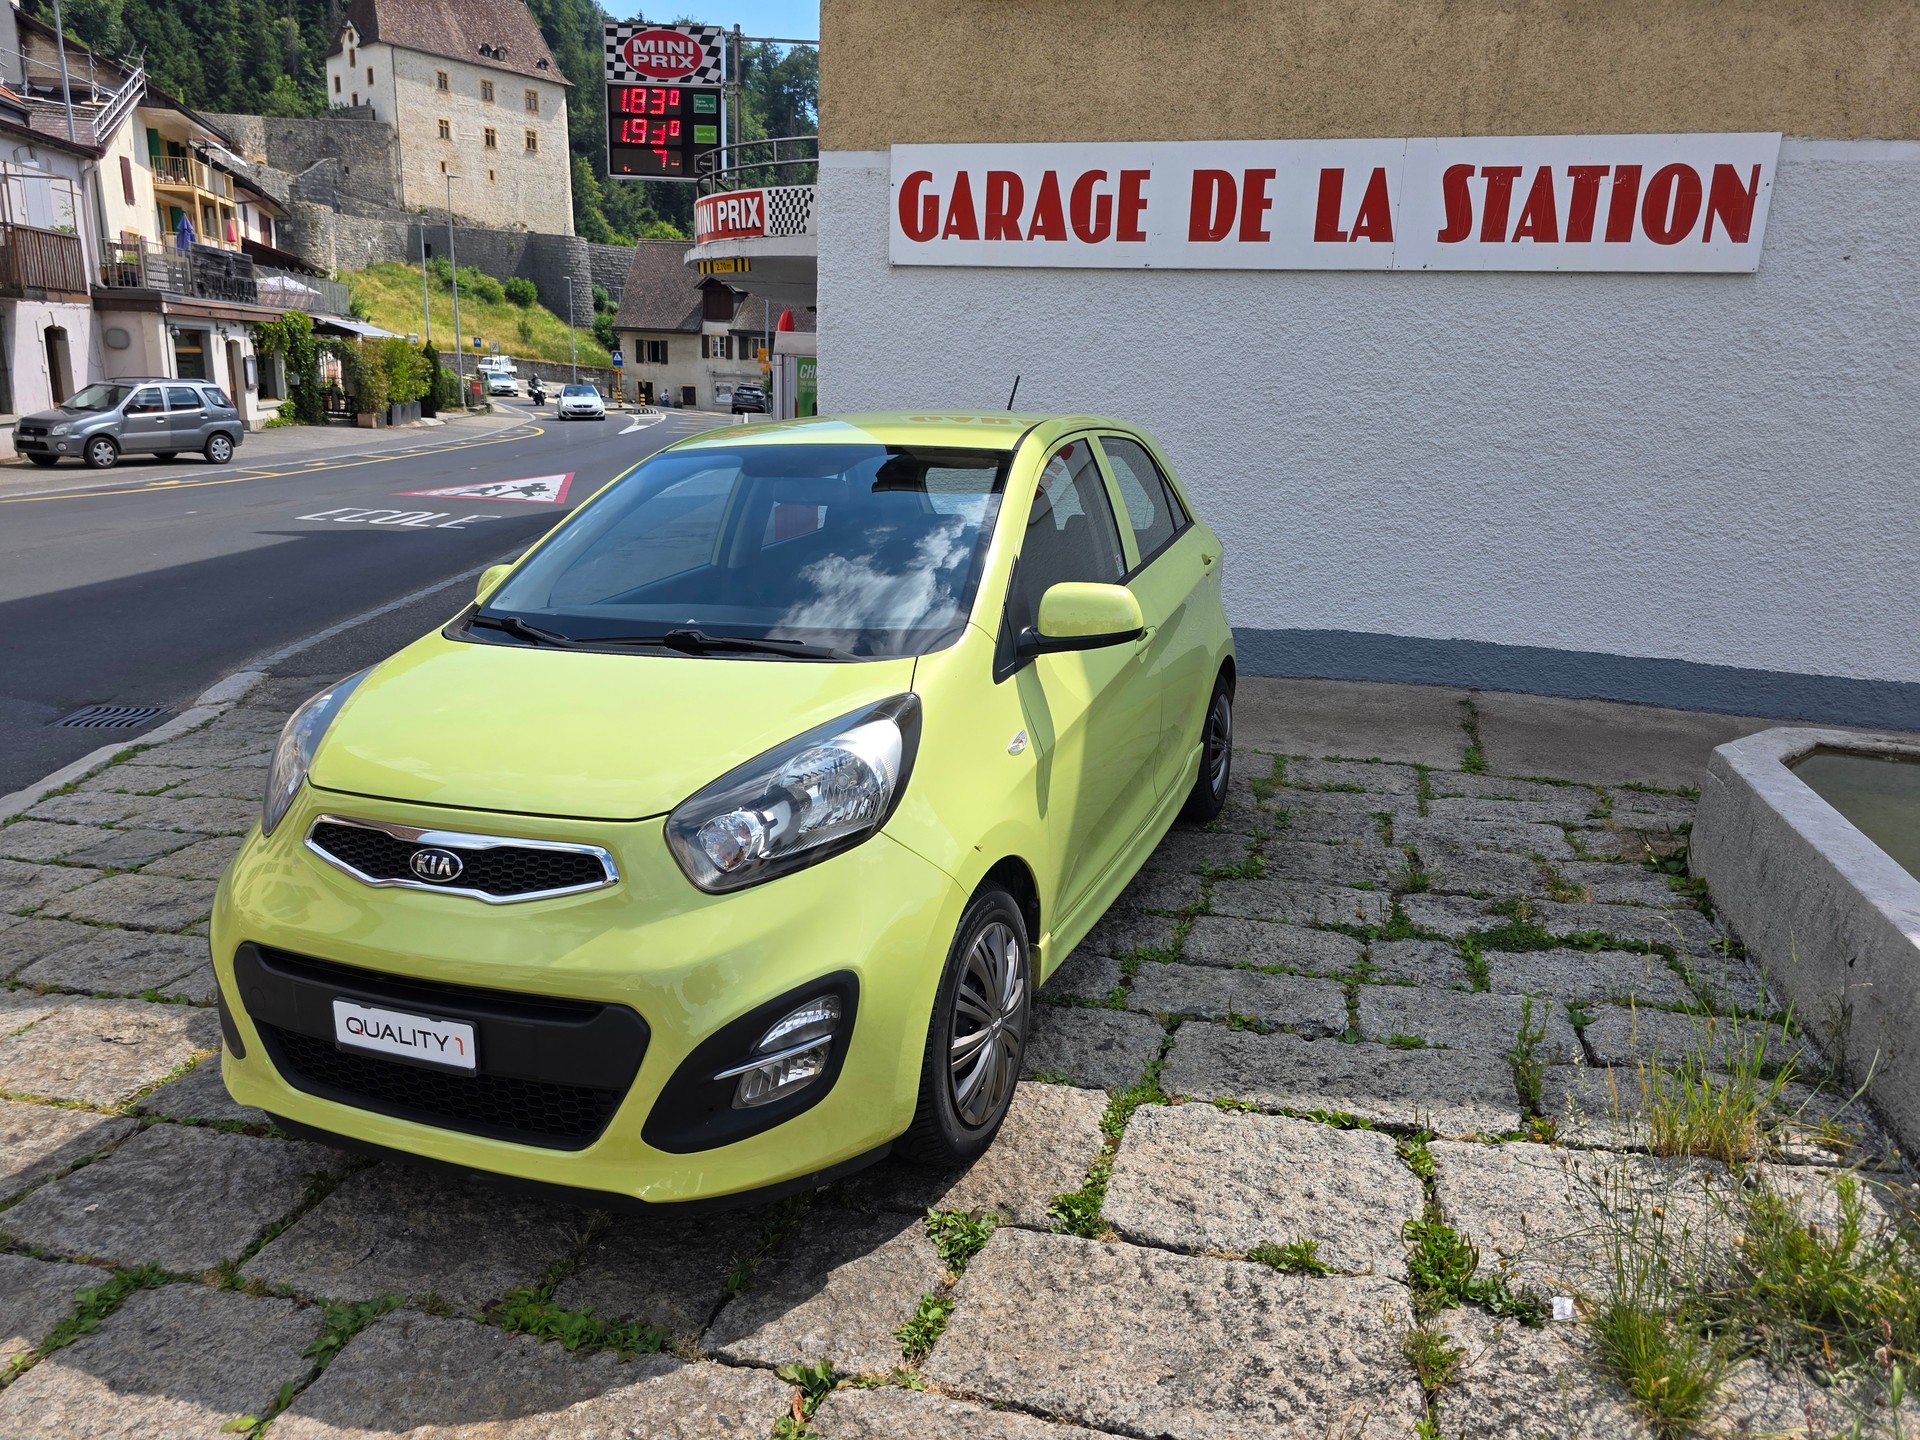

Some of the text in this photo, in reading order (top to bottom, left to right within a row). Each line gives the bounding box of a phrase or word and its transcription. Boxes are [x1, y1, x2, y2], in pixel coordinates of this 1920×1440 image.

[632, 39, 694, 55] MINI
[632, 54, 695, 69] PRIX
[717, 196, 761, 231] PRIX
[898, 162, 1762, 245] GARAGE DE LA STATION
[800, 364, 817, 379] CH
[295, 507, 502, 529] ECOLE
[416, 854, 452, 876] KIA
